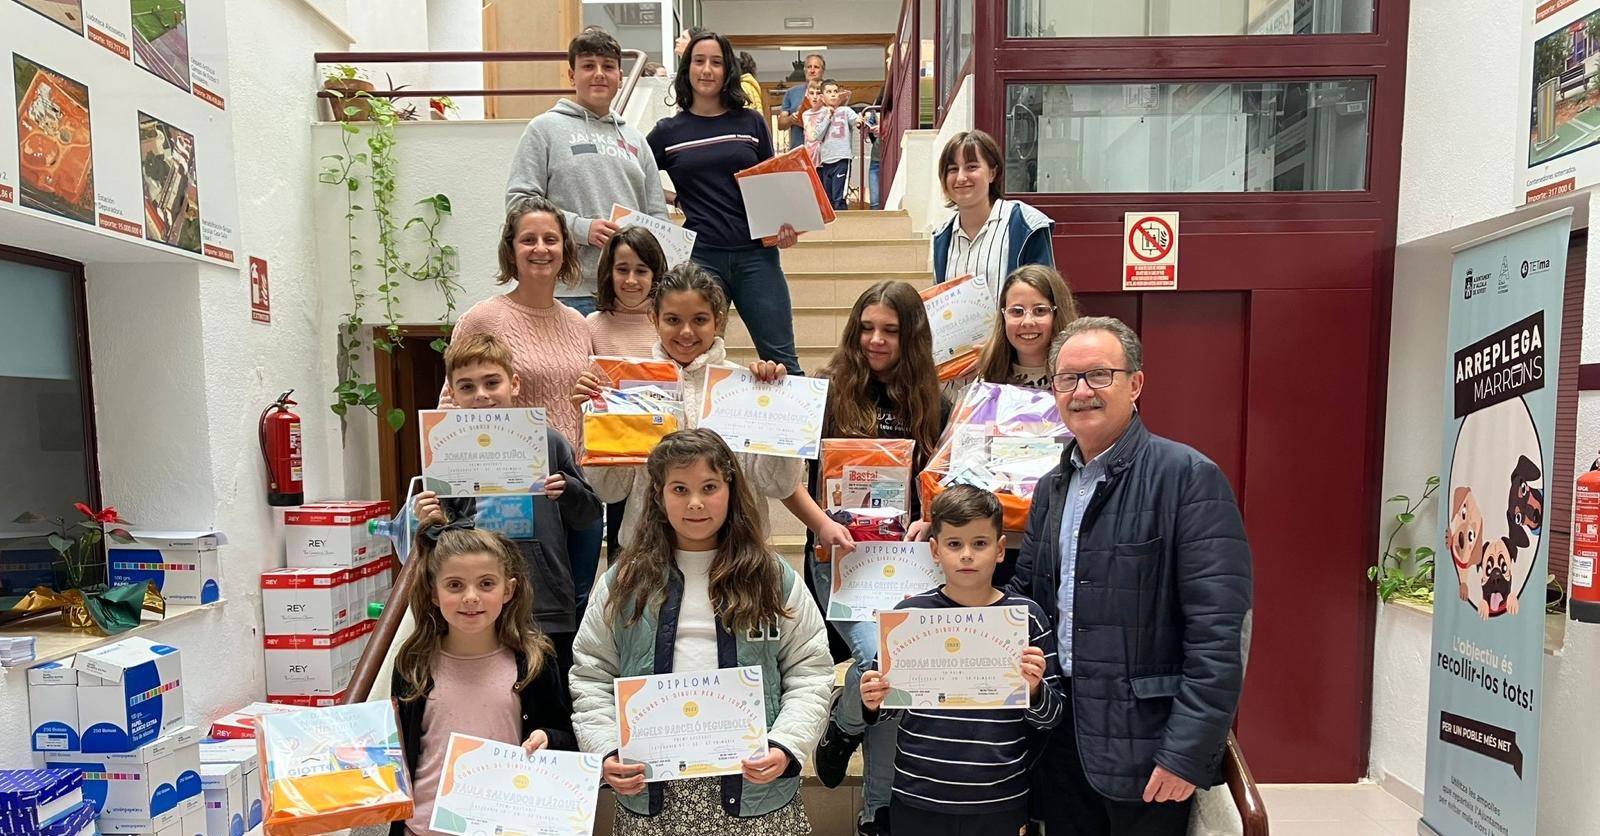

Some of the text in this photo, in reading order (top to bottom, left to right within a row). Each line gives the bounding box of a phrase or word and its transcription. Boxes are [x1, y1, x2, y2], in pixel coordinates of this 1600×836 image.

[1456, 324, 1542, 384] ARREPLEGA
[740, 374, 792, 387] DIOMA
[456, 414, 511, 422] DIPLOMA
[308, 540, 326, 548] REY
[866, 546, 914, 554] DIPLOMA
[287, 604, 306, 612] REY
[920, 613, 984, 625] DIPLOMA
[1453, 635, 1513, 675] L'objectiu és
[658, 674, 720, 690] DIPLOMA
[1438, 652, 1534, 712] recollir-los tots!
[1442, 722, 1512, 753] PER UN POBLE MÉS NET
[494, 747, 558, 766] DIPLOMA
[288, 764, 334, 776] GIOTTO
[1451, 776, 1468, 794] Utilitza
[1477, 795, 1500, 816] ampolles
